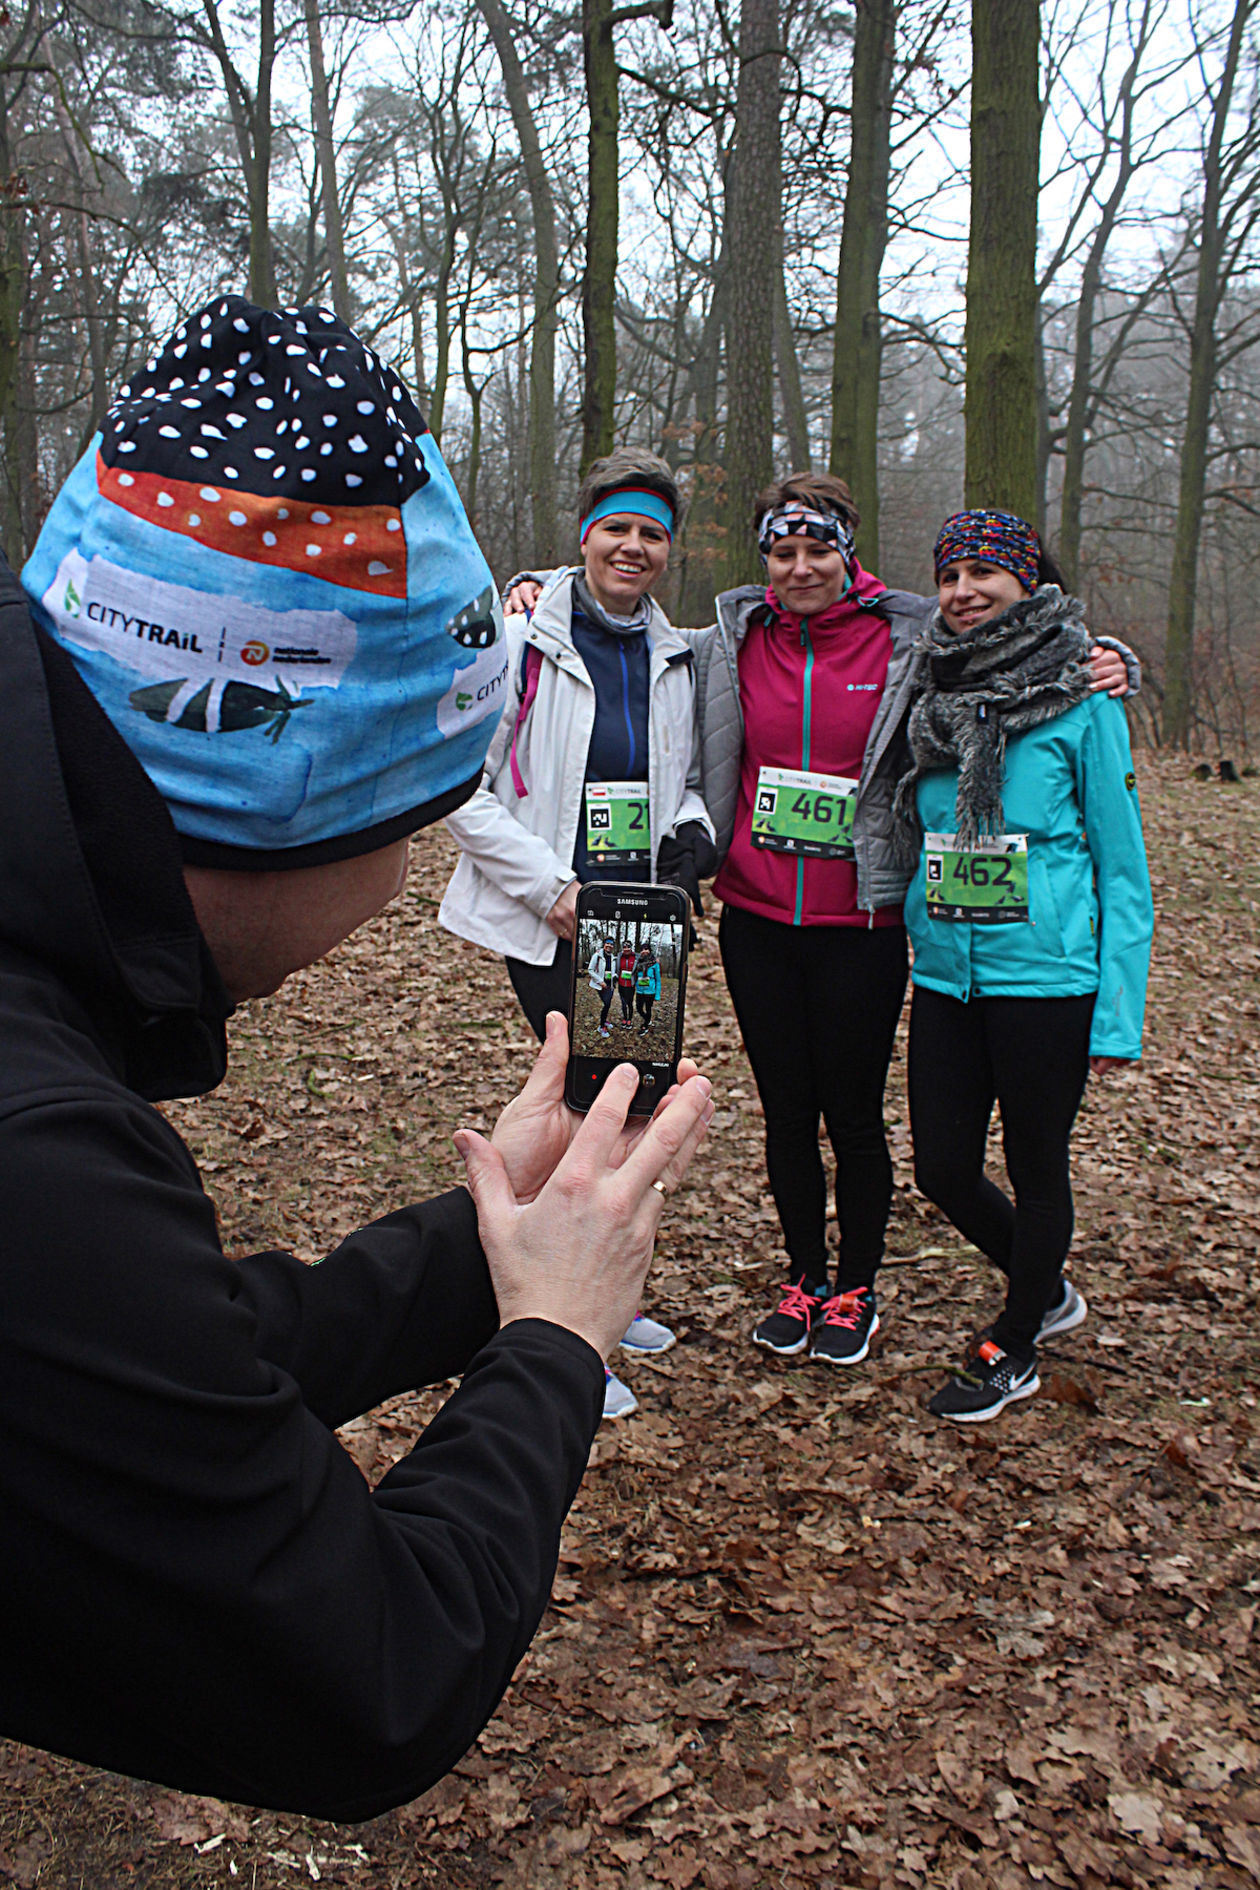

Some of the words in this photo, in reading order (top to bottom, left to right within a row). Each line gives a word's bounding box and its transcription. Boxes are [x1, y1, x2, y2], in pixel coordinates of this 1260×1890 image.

[792, 793, 848, 826] 461
[953, 856, 1012, 886] 462
[617, 898, 648, 906] SAMSUNG
